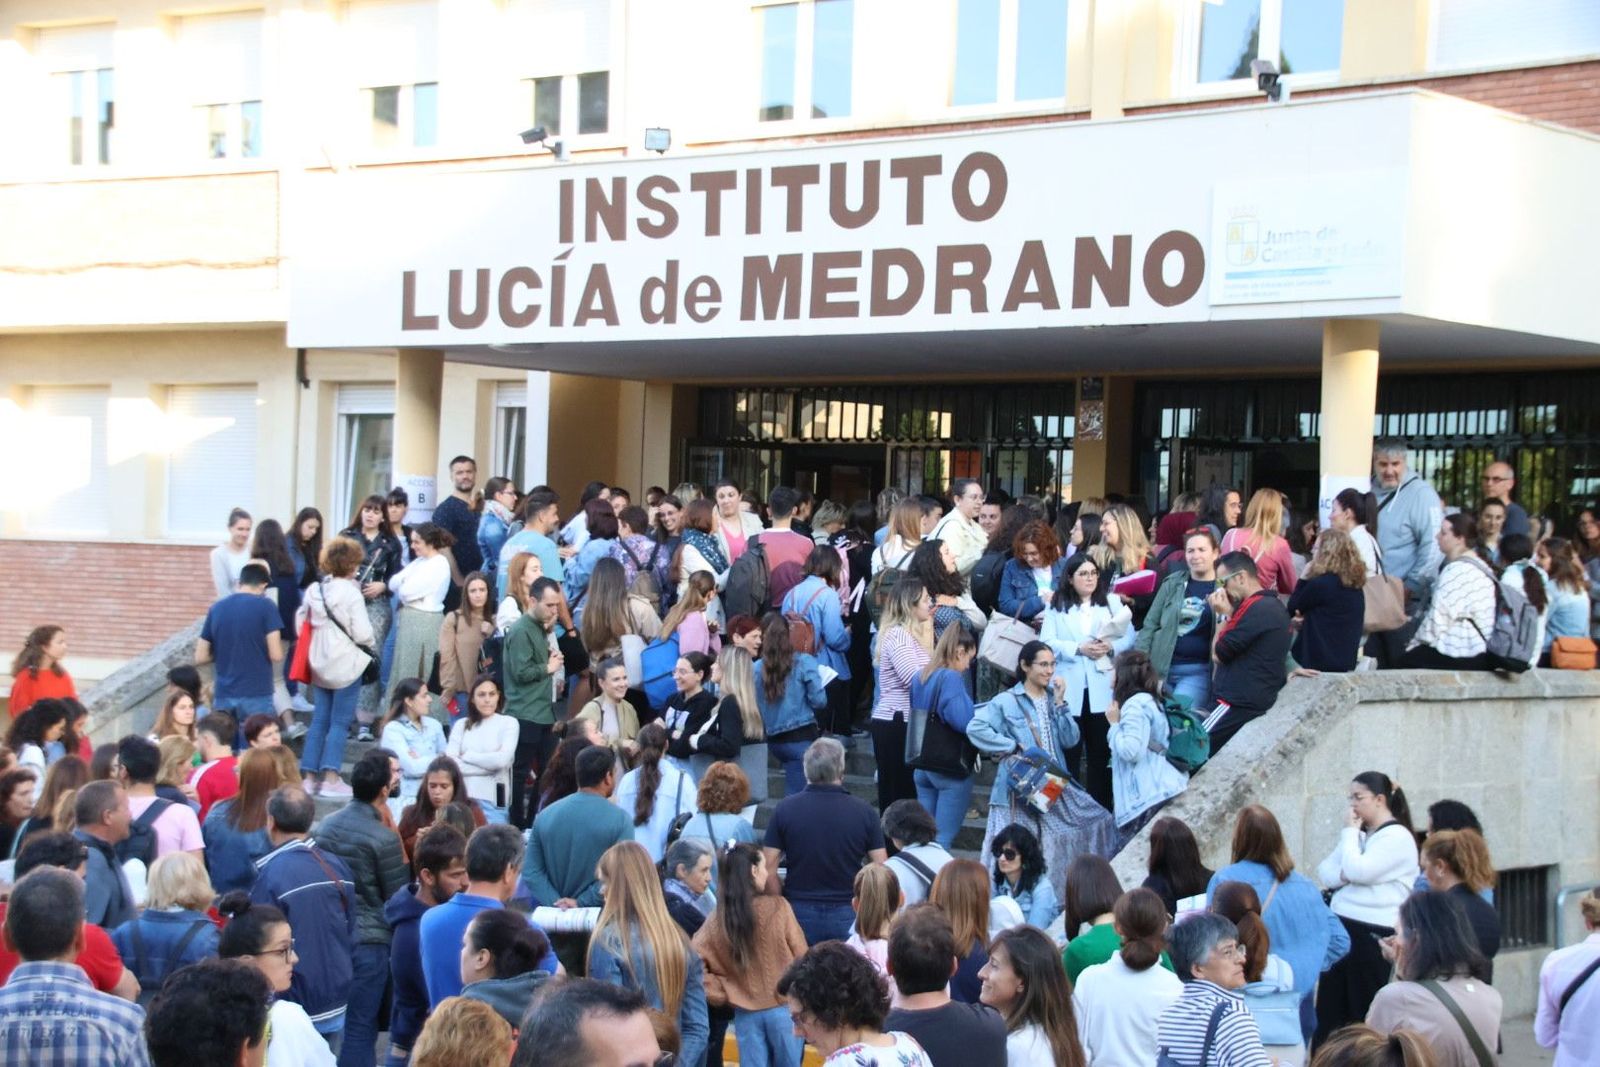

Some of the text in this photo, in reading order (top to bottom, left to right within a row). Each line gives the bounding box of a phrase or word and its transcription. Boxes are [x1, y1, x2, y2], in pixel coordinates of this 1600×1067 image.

[558, 151, 1009, 244] INSTITUTO
[402, 230, 1206, 331] LUCÍA de MEDRANO
[418, 493, 426, 504] B
